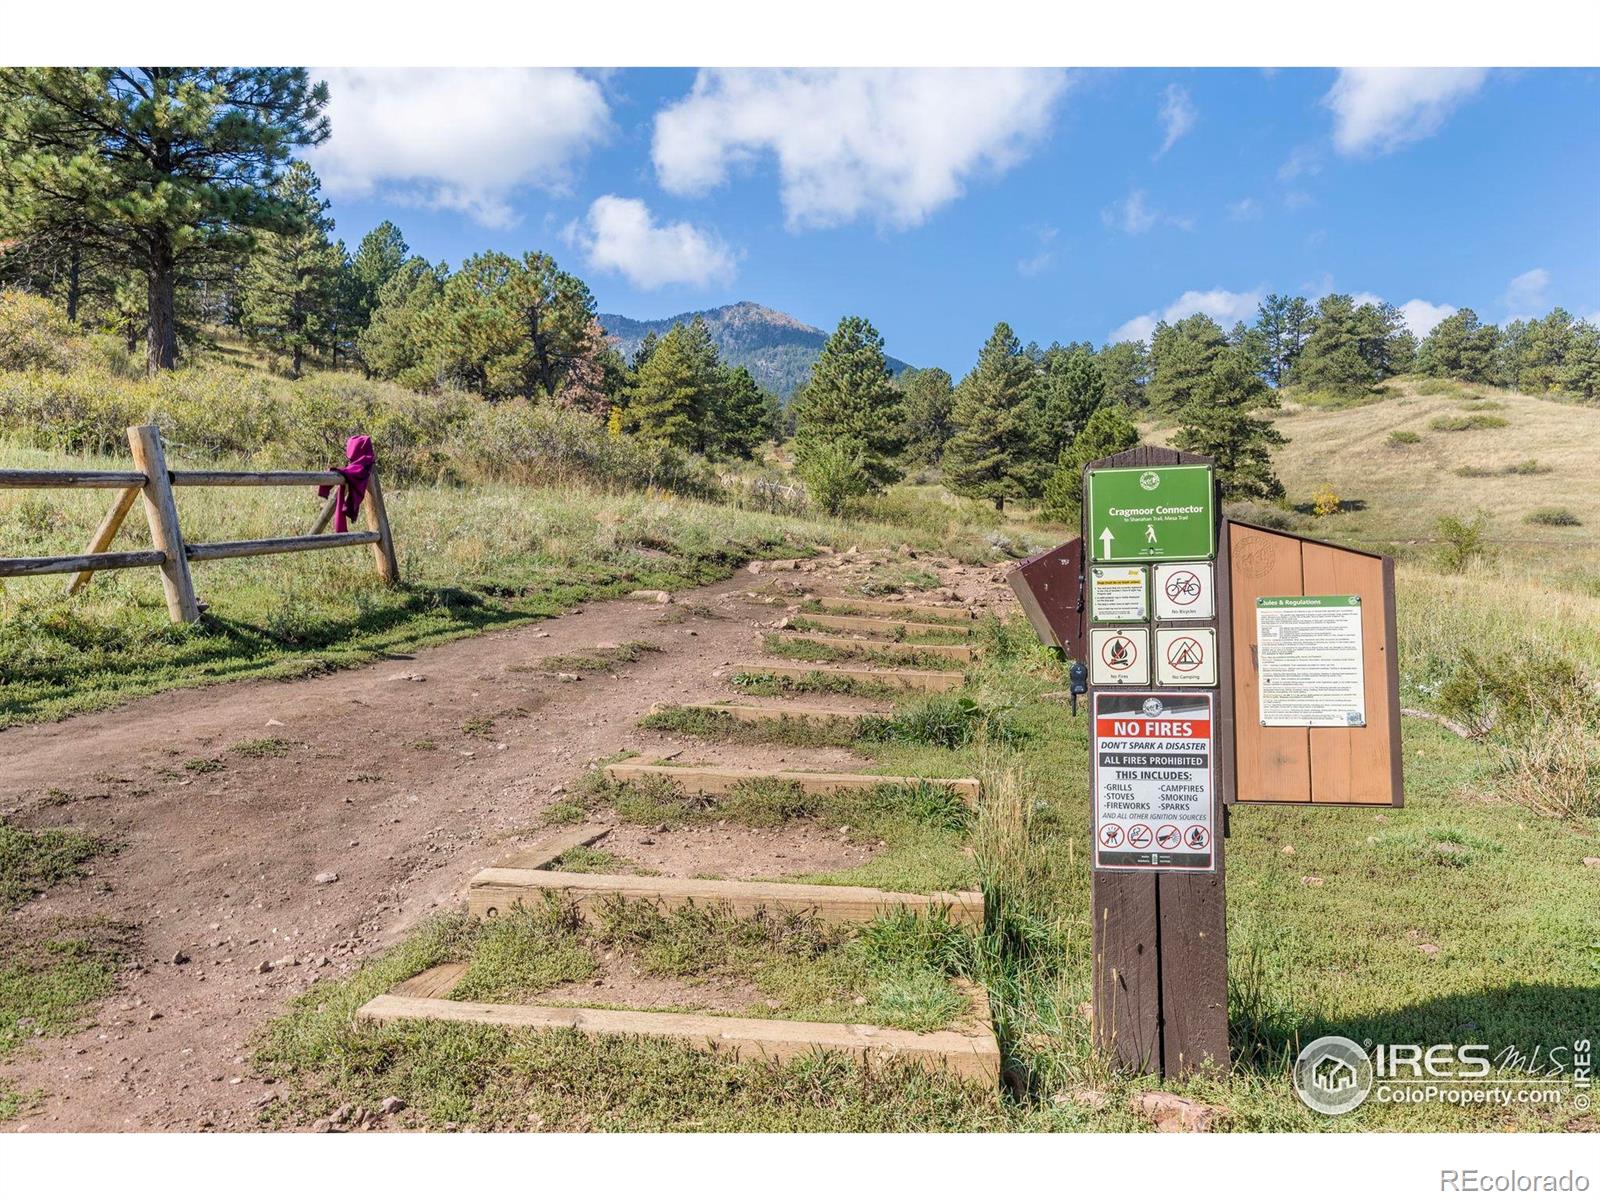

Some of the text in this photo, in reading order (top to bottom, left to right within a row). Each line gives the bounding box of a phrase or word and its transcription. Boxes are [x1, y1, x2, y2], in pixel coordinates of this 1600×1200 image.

[1109, 505, 1204, 517] Cragmoor Connector
[1285, 599, 1322, 607] Regulations
[1114, 721, 1193, 737] NO FIRES
[1101, 741, 1206, 751] DON'T SPARK A DISASTER
[1104, 756, 1203, 766] ALL FIRES PROHIBITED
[1116, 770, 1193, 781] THIS INCLUDES:
[1150, 813, 1178, 821] IGNITION
